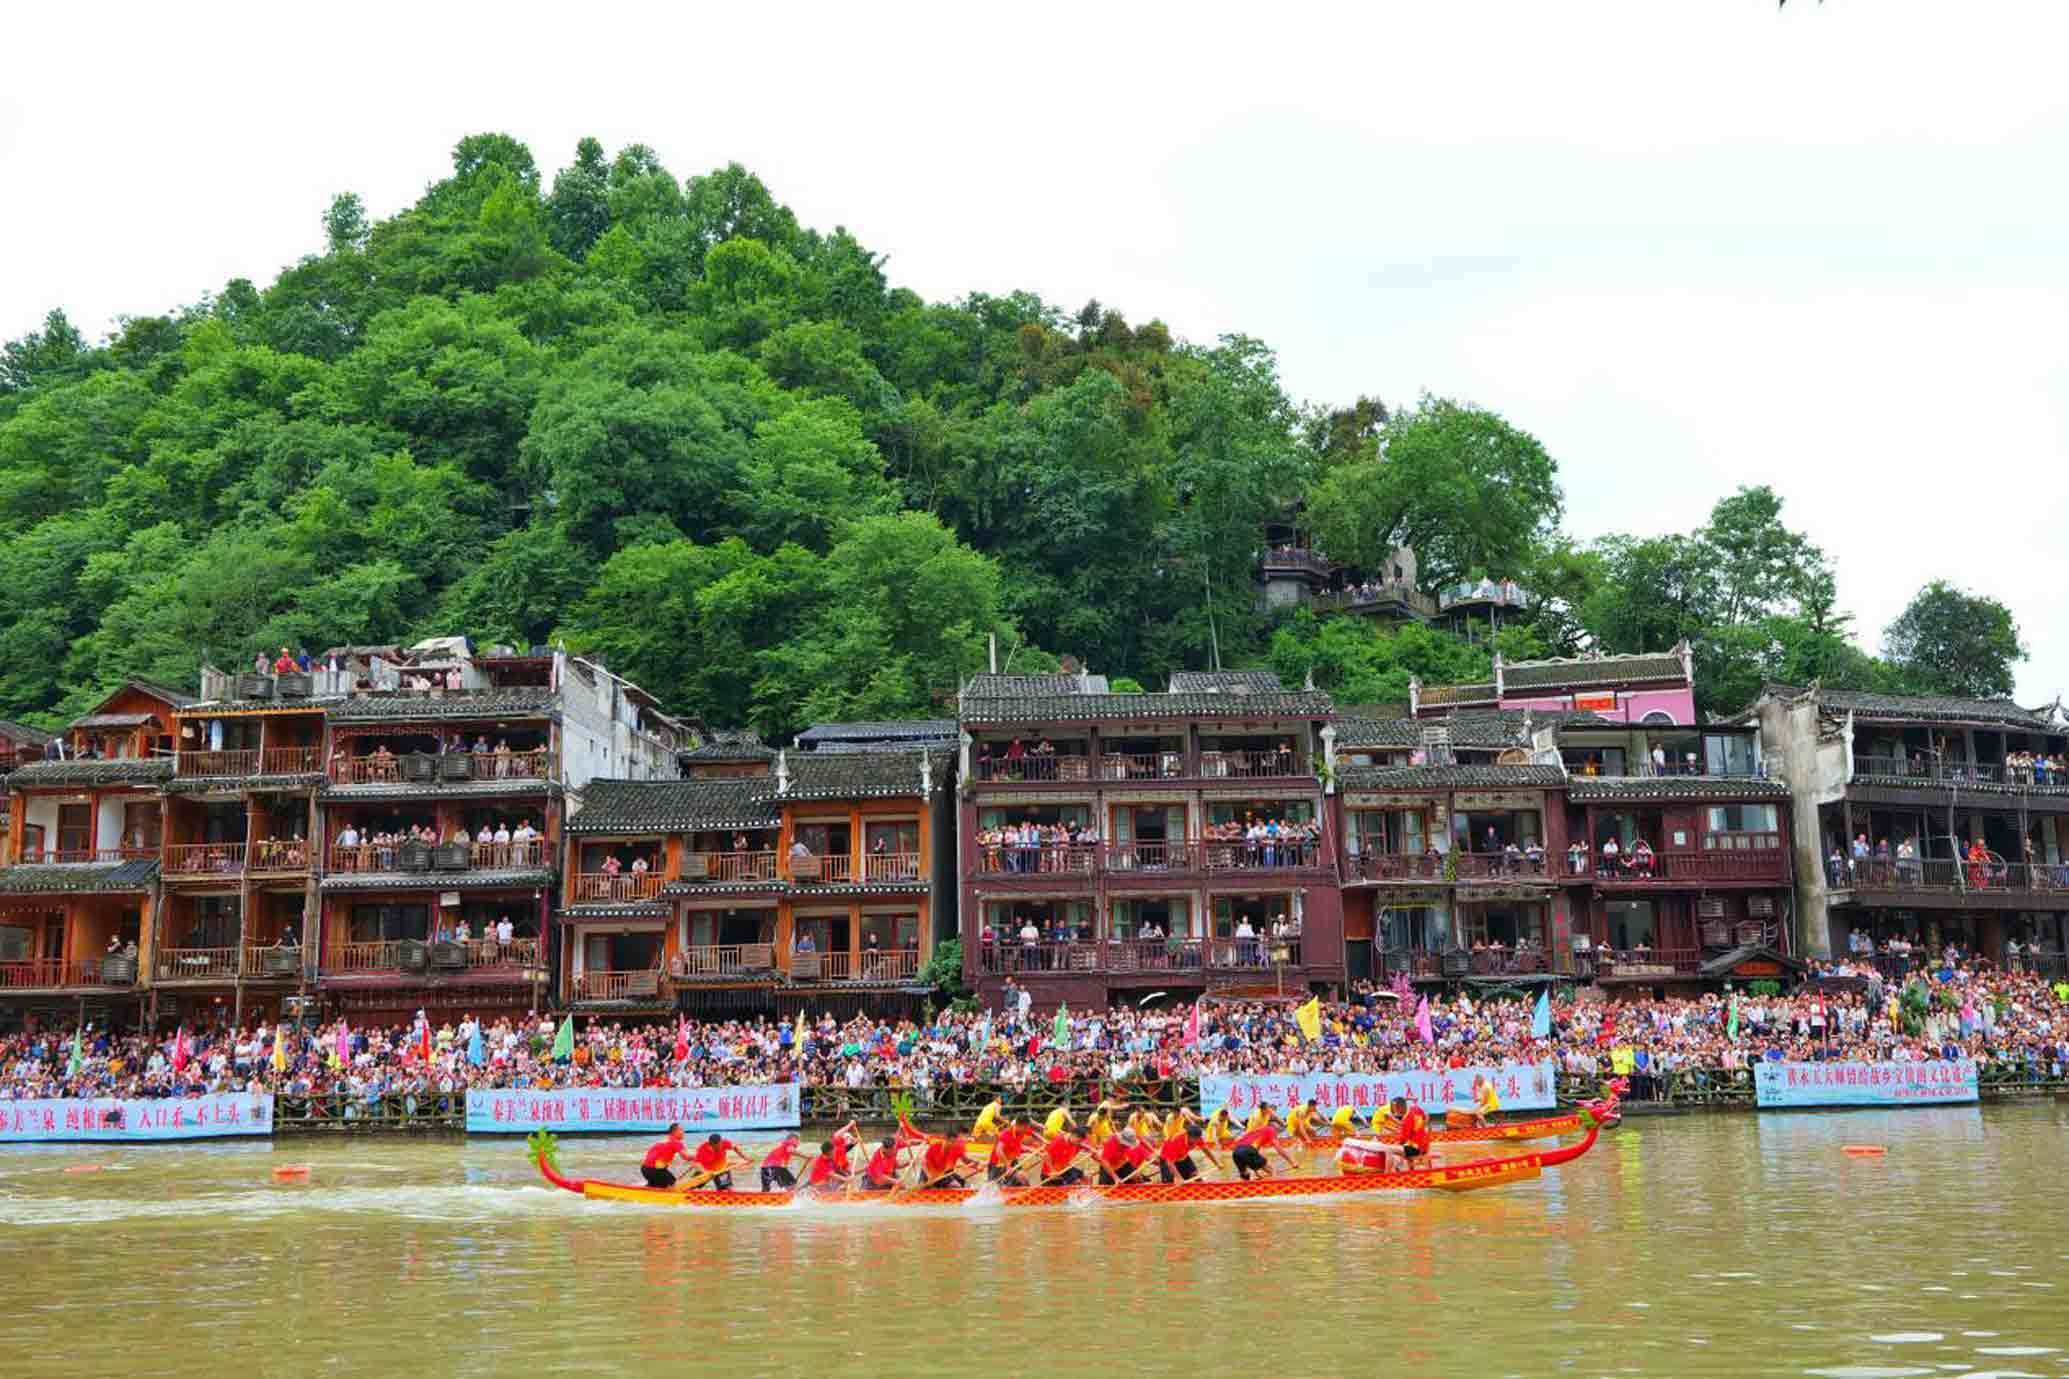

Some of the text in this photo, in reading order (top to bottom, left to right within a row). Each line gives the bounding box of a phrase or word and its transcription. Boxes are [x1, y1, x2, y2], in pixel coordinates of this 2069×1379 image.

[1314, 1079, 1388, 1108] 纯粮酿造
[1404, 1079, 1456, 1104] 入口柔
[139, 1103, 183, 1128] 入口柔
[197, 1102, 240, 1127] 不上头
